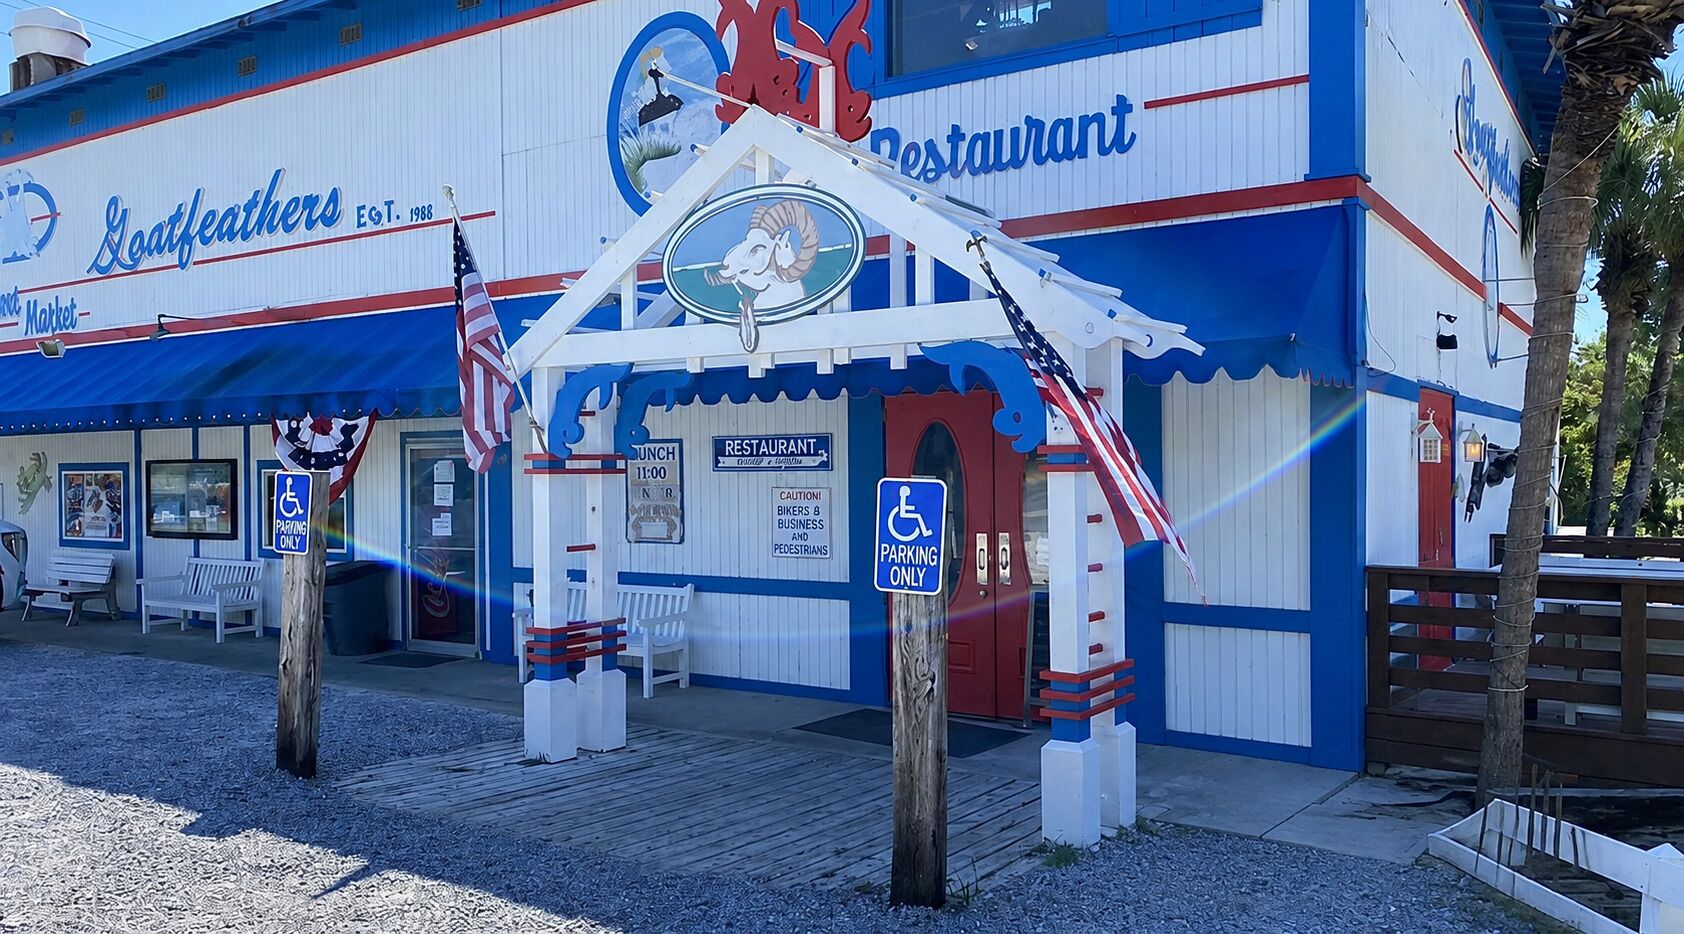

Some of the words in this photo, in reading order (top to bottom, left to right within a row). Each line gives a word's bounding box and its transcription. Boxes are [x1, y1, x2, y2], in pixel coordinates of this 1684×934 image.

[870, 94, 1136, 184] Restaurant
[86, 168, 342, 275] Goatfeathers
[410, 203, 433, 222] 1988
[24, 295, 77, 336] Market
[636, 446, 675, 460] UNCH
[725, 438, 817, 455] RESTAURANT
[636, 466, 667, 479] 11:00
[777, 505, 810, 516] BIKERS
[275, 519, 307, 536] PARKING
[777, 518, 824, 530] BUSINESS
[280, 534, 301, 550] ONLY
[791, 532, 809, 542] AND
[880, 543, 938, 566] PARKING
[890, 565, 927, 587] ONLY
